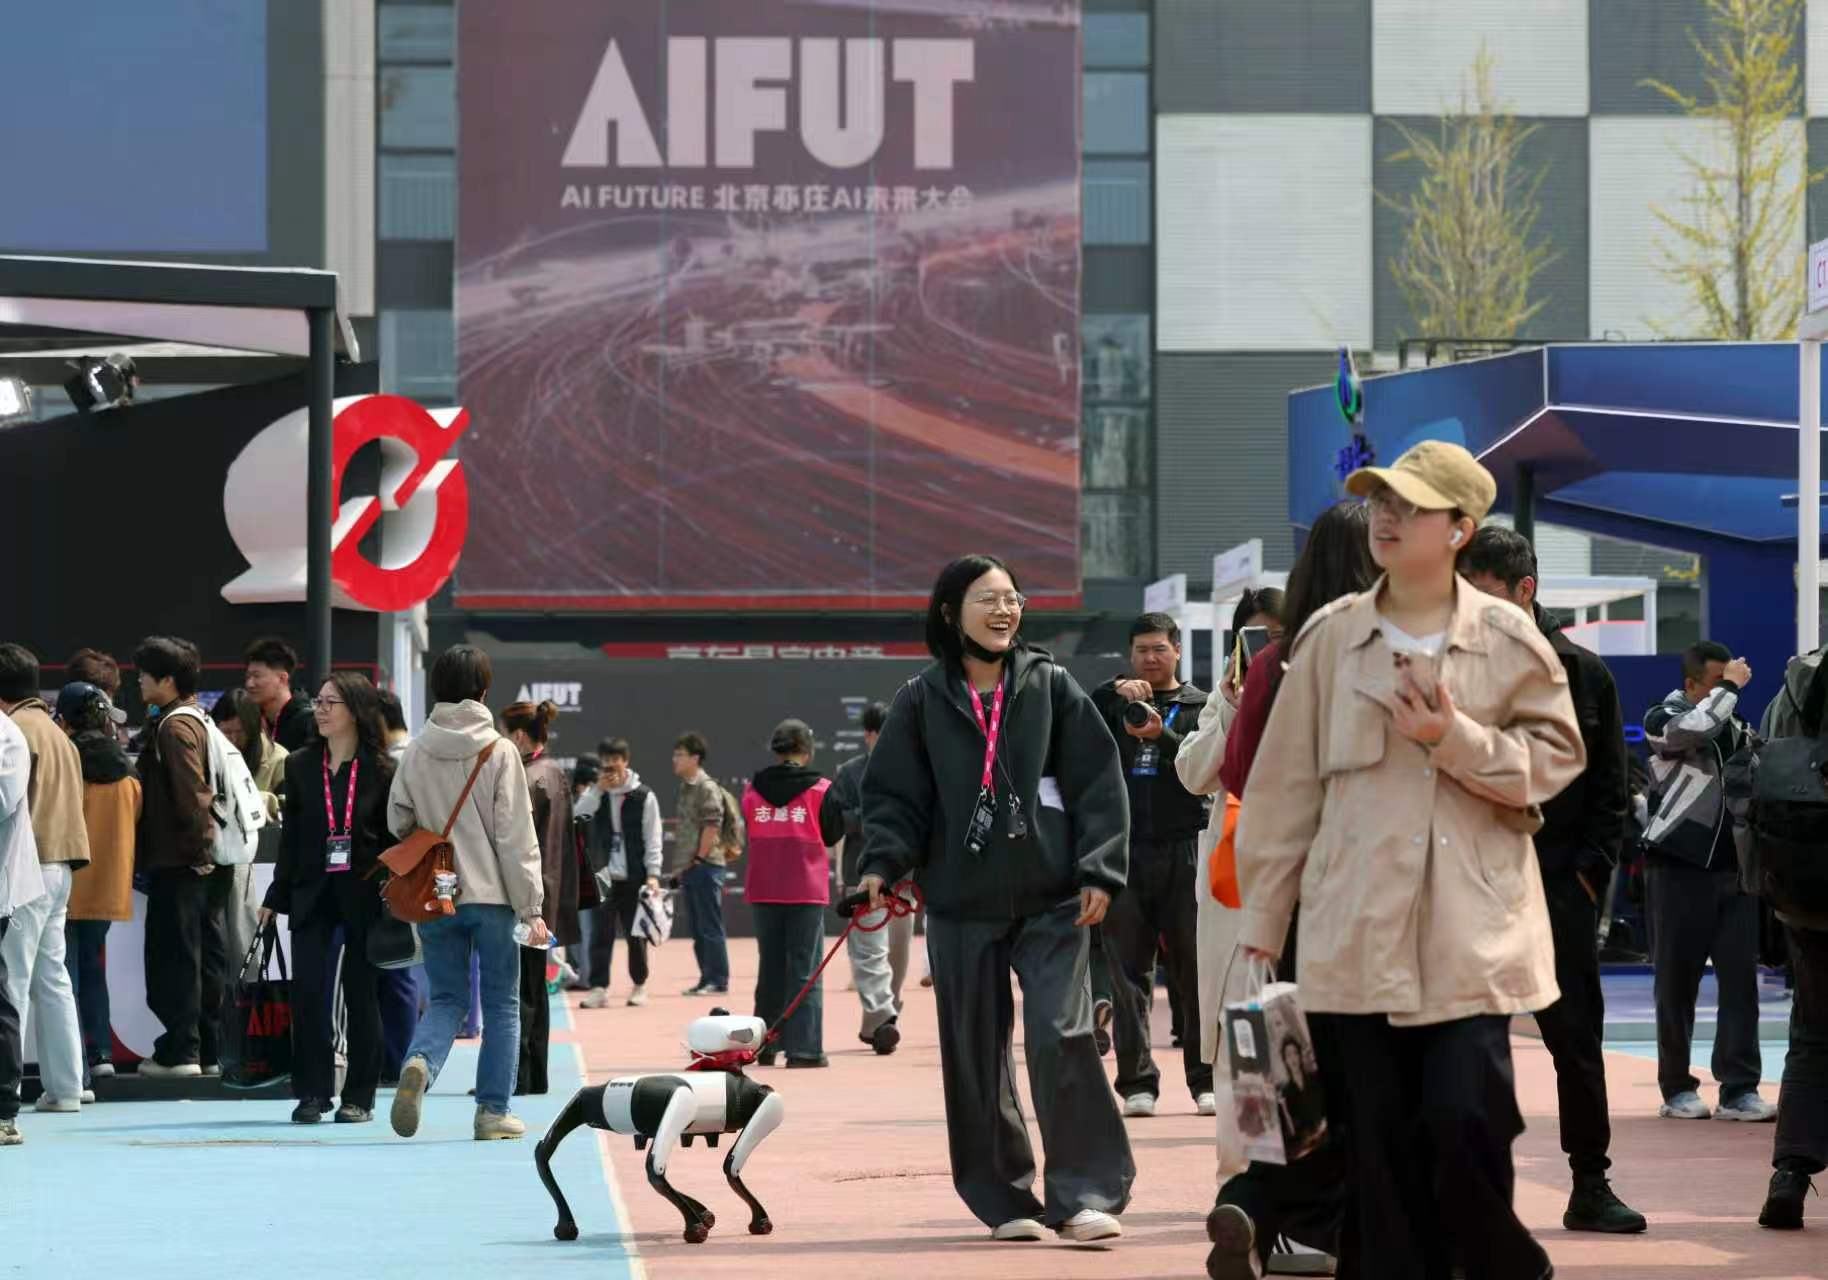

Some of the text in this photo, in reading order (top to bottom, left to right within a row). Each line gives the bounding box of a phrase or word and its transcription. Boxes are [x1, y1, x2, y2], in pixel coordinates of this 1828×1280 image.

[562, 37, 975, 168] AIFUT
[561, 185, 974, 212] AI FUTURE 北京亦庄AI未来大会
[754, 806, 807, 823] 志愿者
